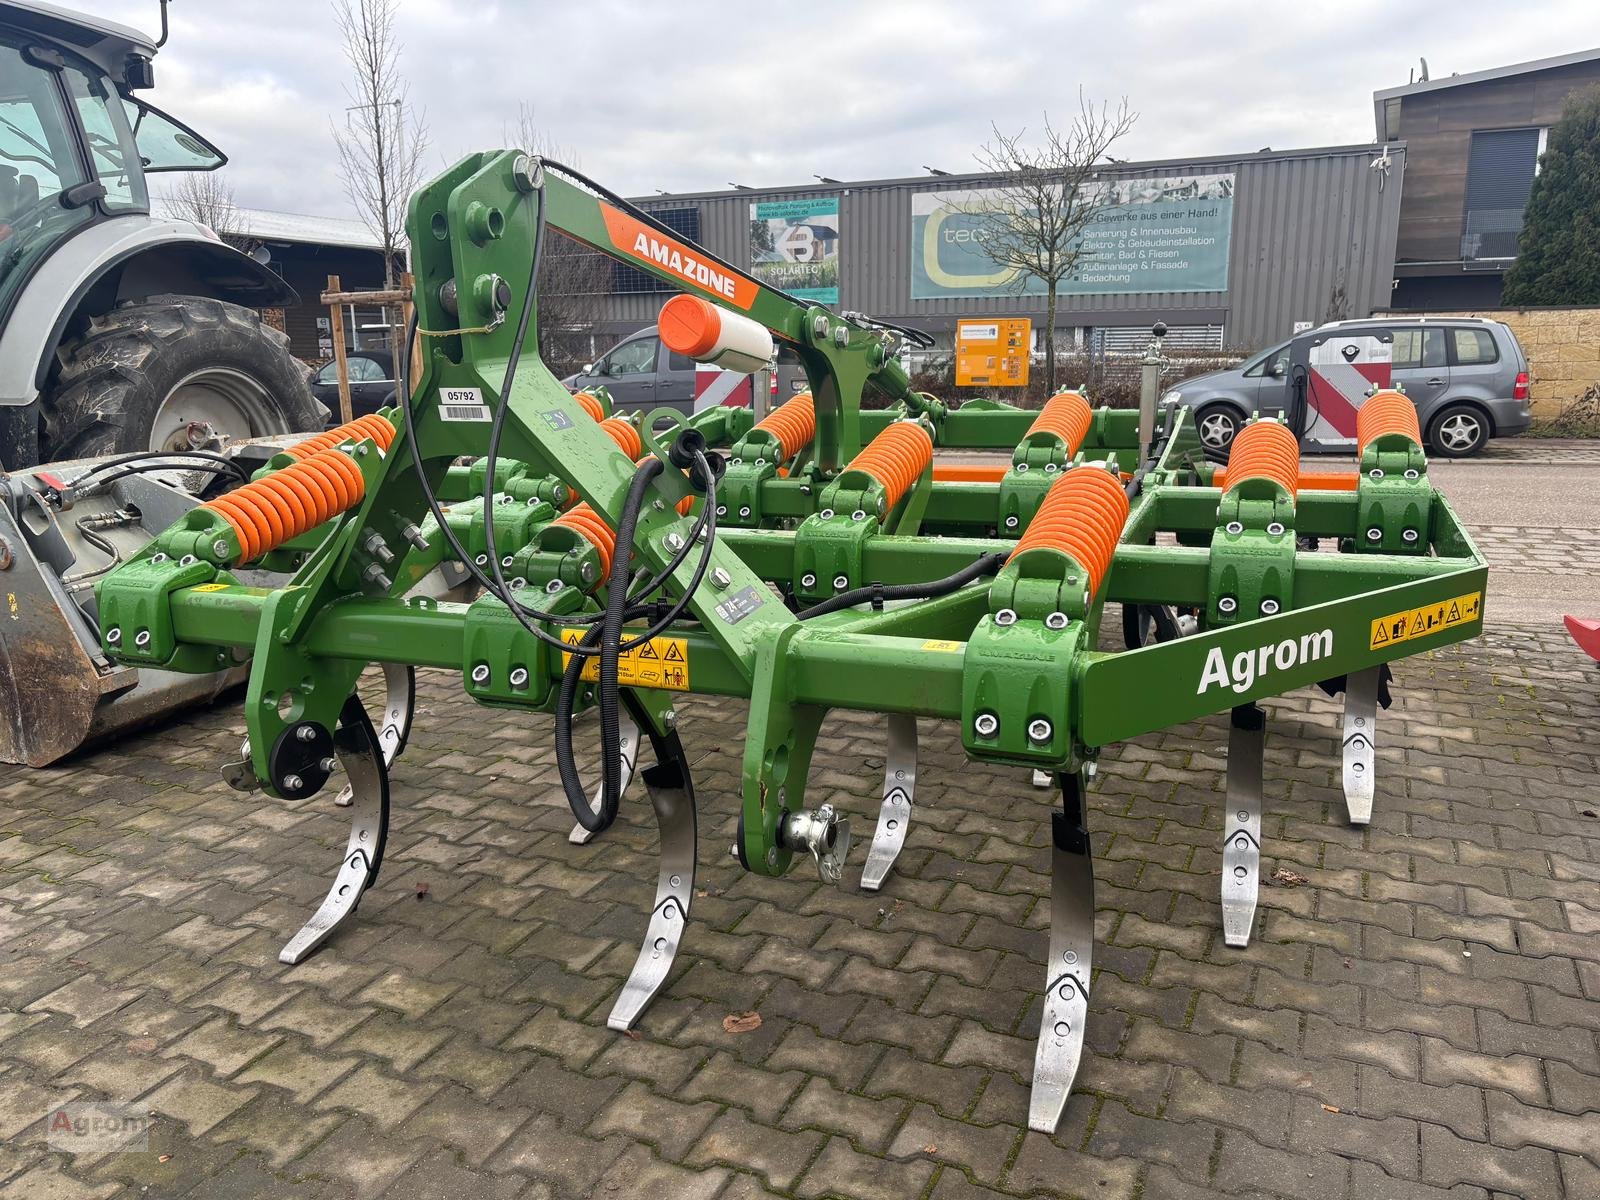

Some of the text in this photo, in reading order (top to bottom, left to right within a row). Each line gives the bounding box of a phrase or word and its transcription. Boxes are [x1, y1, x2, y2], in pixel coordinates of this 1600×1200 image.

[1096, 211, 1138, 223] Gewerke
[1140, 212, 1158, 221] aus
[1160, 210, 1184, 220] einer
[1187, 208, 1218, 219] Hand!
[1083, 225, 1197, 239] Sanierung & Innenausbau
[1083, 239, 1116, 250] Elektro-
[1118, 239, 1126, 249] &
[1118, 250, 1136, 260] Bad
[1138, 249, 1146, 259] &
[1148, 249, 1180, 259] Fliesen
[633, 232, 735, 299] AMAZONE
[1082, 260, 1189, 272] Außenanlage & Fassade
[1082, 272, 1131, 283] Bedachung
[447, 391, 475, 401] 05792
[1196, 628, 1334, 694] Agrom
